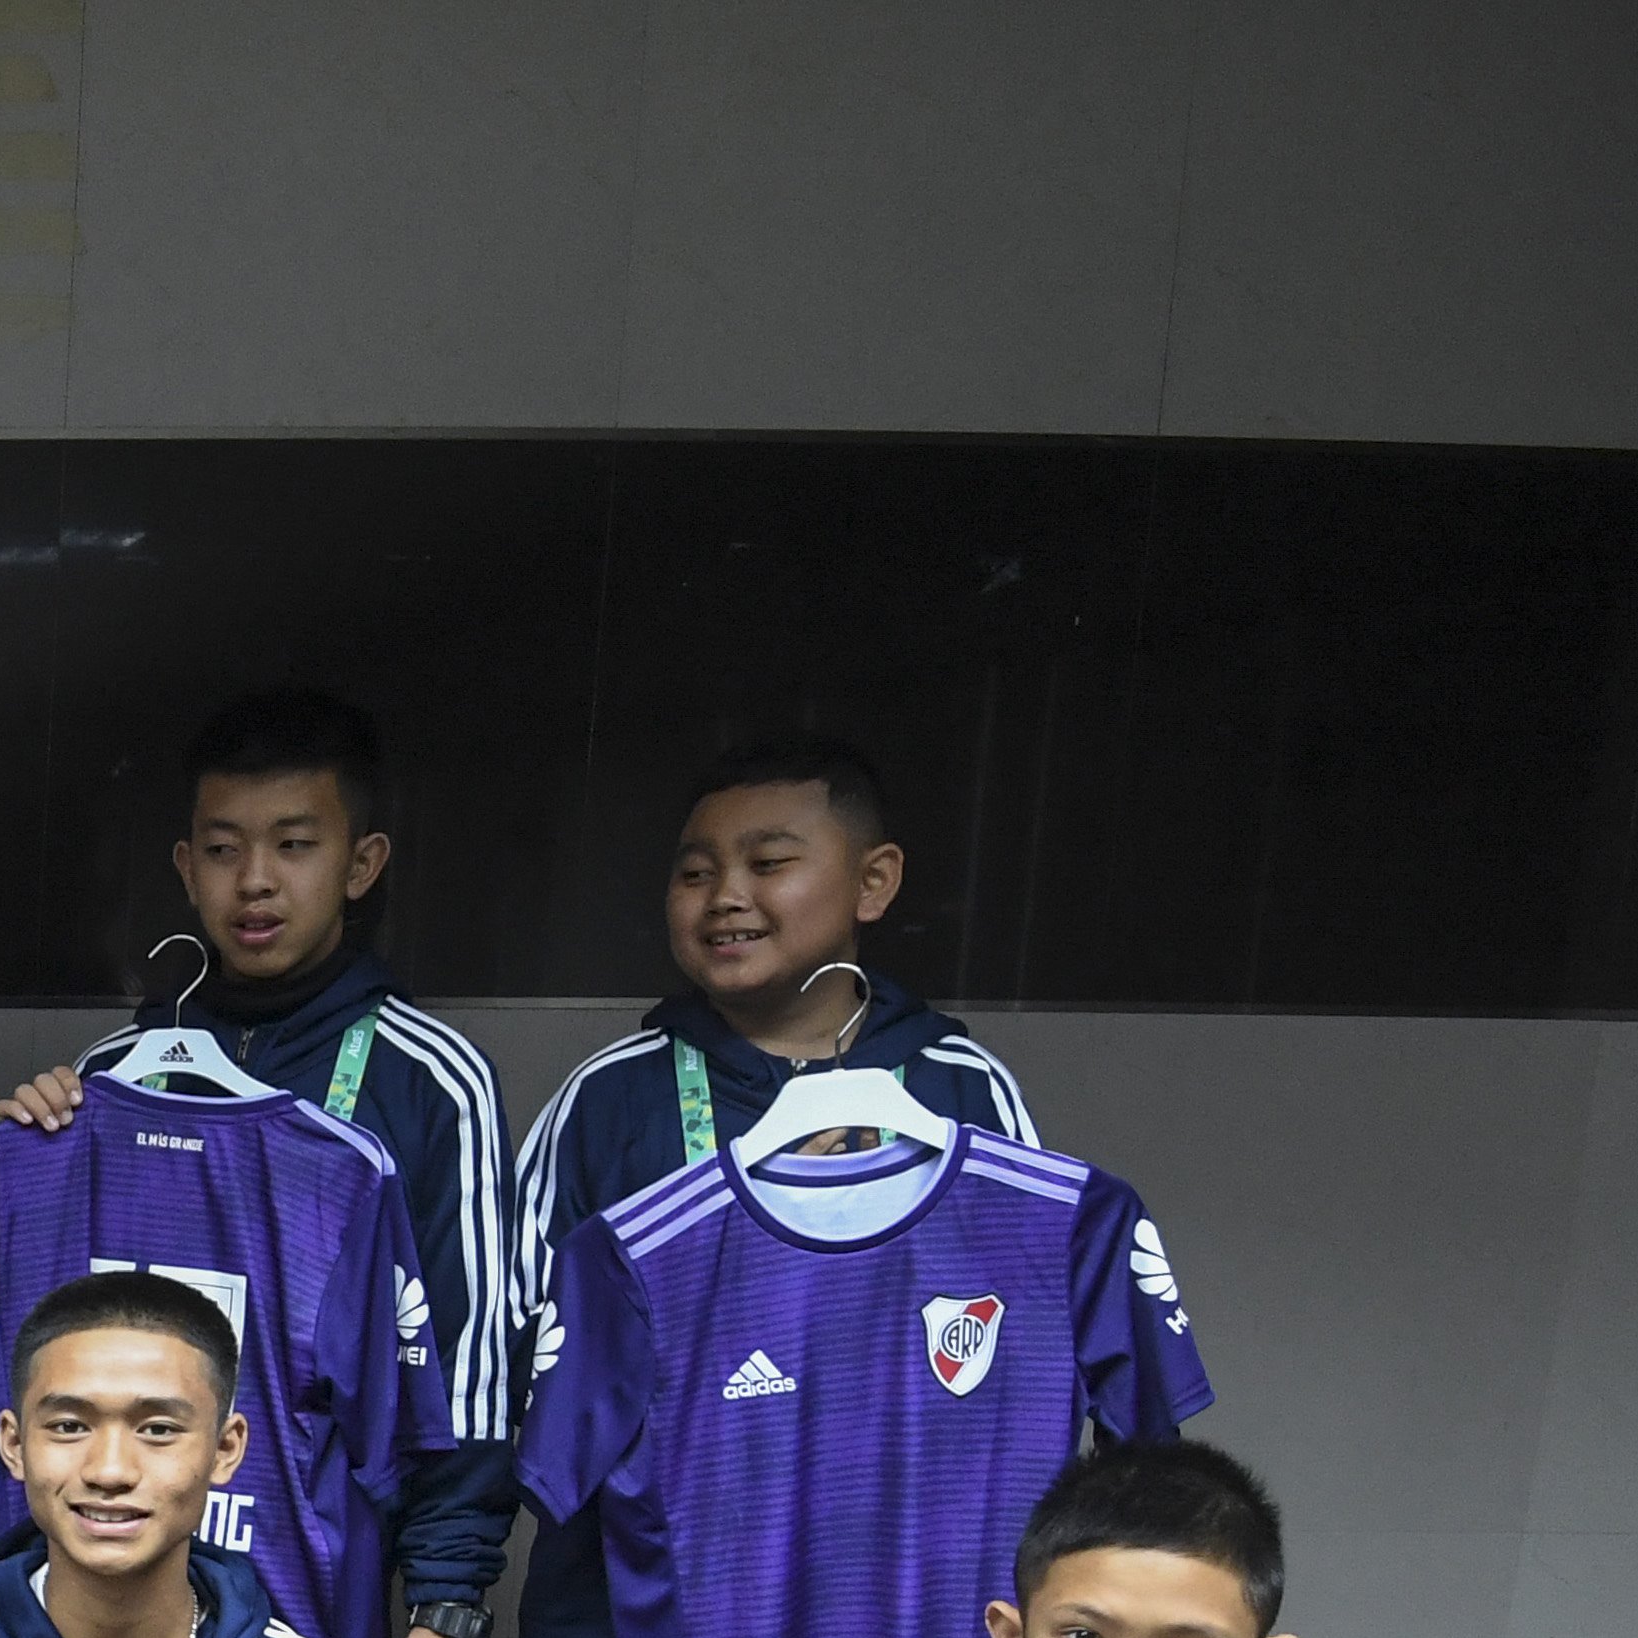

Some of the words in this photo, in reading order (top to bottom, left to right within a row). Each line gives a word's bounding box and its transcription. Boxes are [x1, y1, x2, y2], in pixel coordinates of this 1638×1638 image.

[136, 1131, 147, 1147] EL
[940, 1315, 986, 1361] CARP
[722, 1376, 797, 1400] adidas
